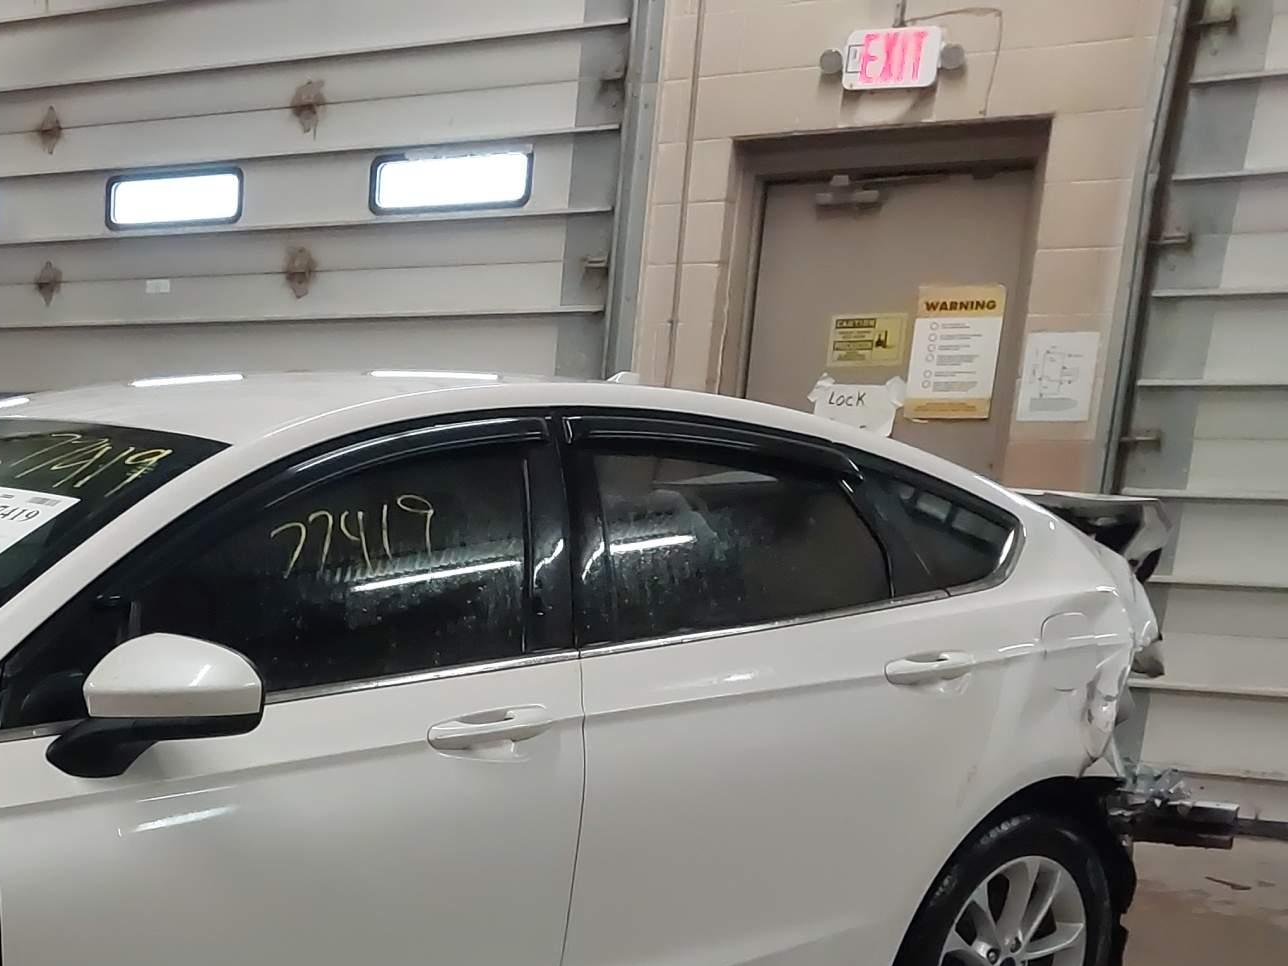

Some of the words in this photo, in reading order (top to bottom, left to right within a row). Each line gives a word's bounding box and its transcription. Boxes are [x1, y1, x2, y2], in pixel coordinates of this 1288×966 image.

[858, 31, 928, 83] EXIT
[925, 300, 997, 312] WARNING
[828, 391, 866, 407] LOCK
[270, 494, 434, 580] 77419
